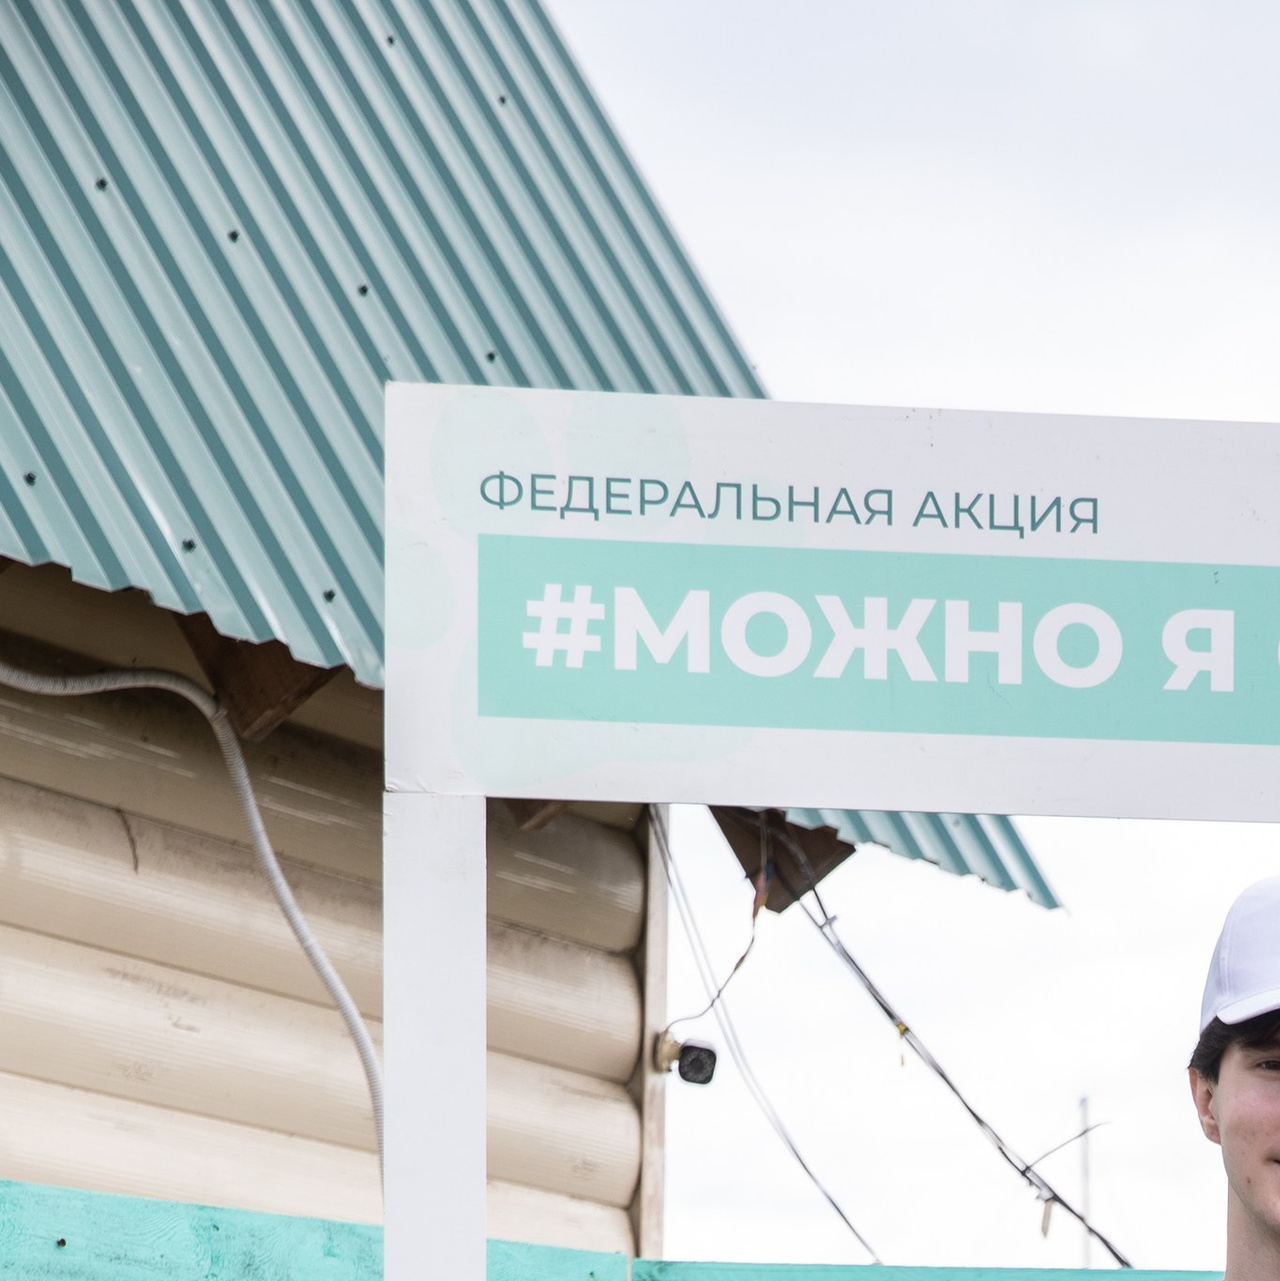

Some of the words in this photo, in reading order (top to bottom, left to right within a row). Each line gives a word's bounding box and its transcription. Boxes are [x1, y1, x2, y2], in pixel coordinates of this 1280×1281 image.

[478, 469, 894, 527] ФЕДЕРАЛЬНАЯ
[912, 490, 1100, 539] АКЦИЯ
[521, 582, 1124, 690] #МОЖНО
[1161, 608, 1236, 693] Я
